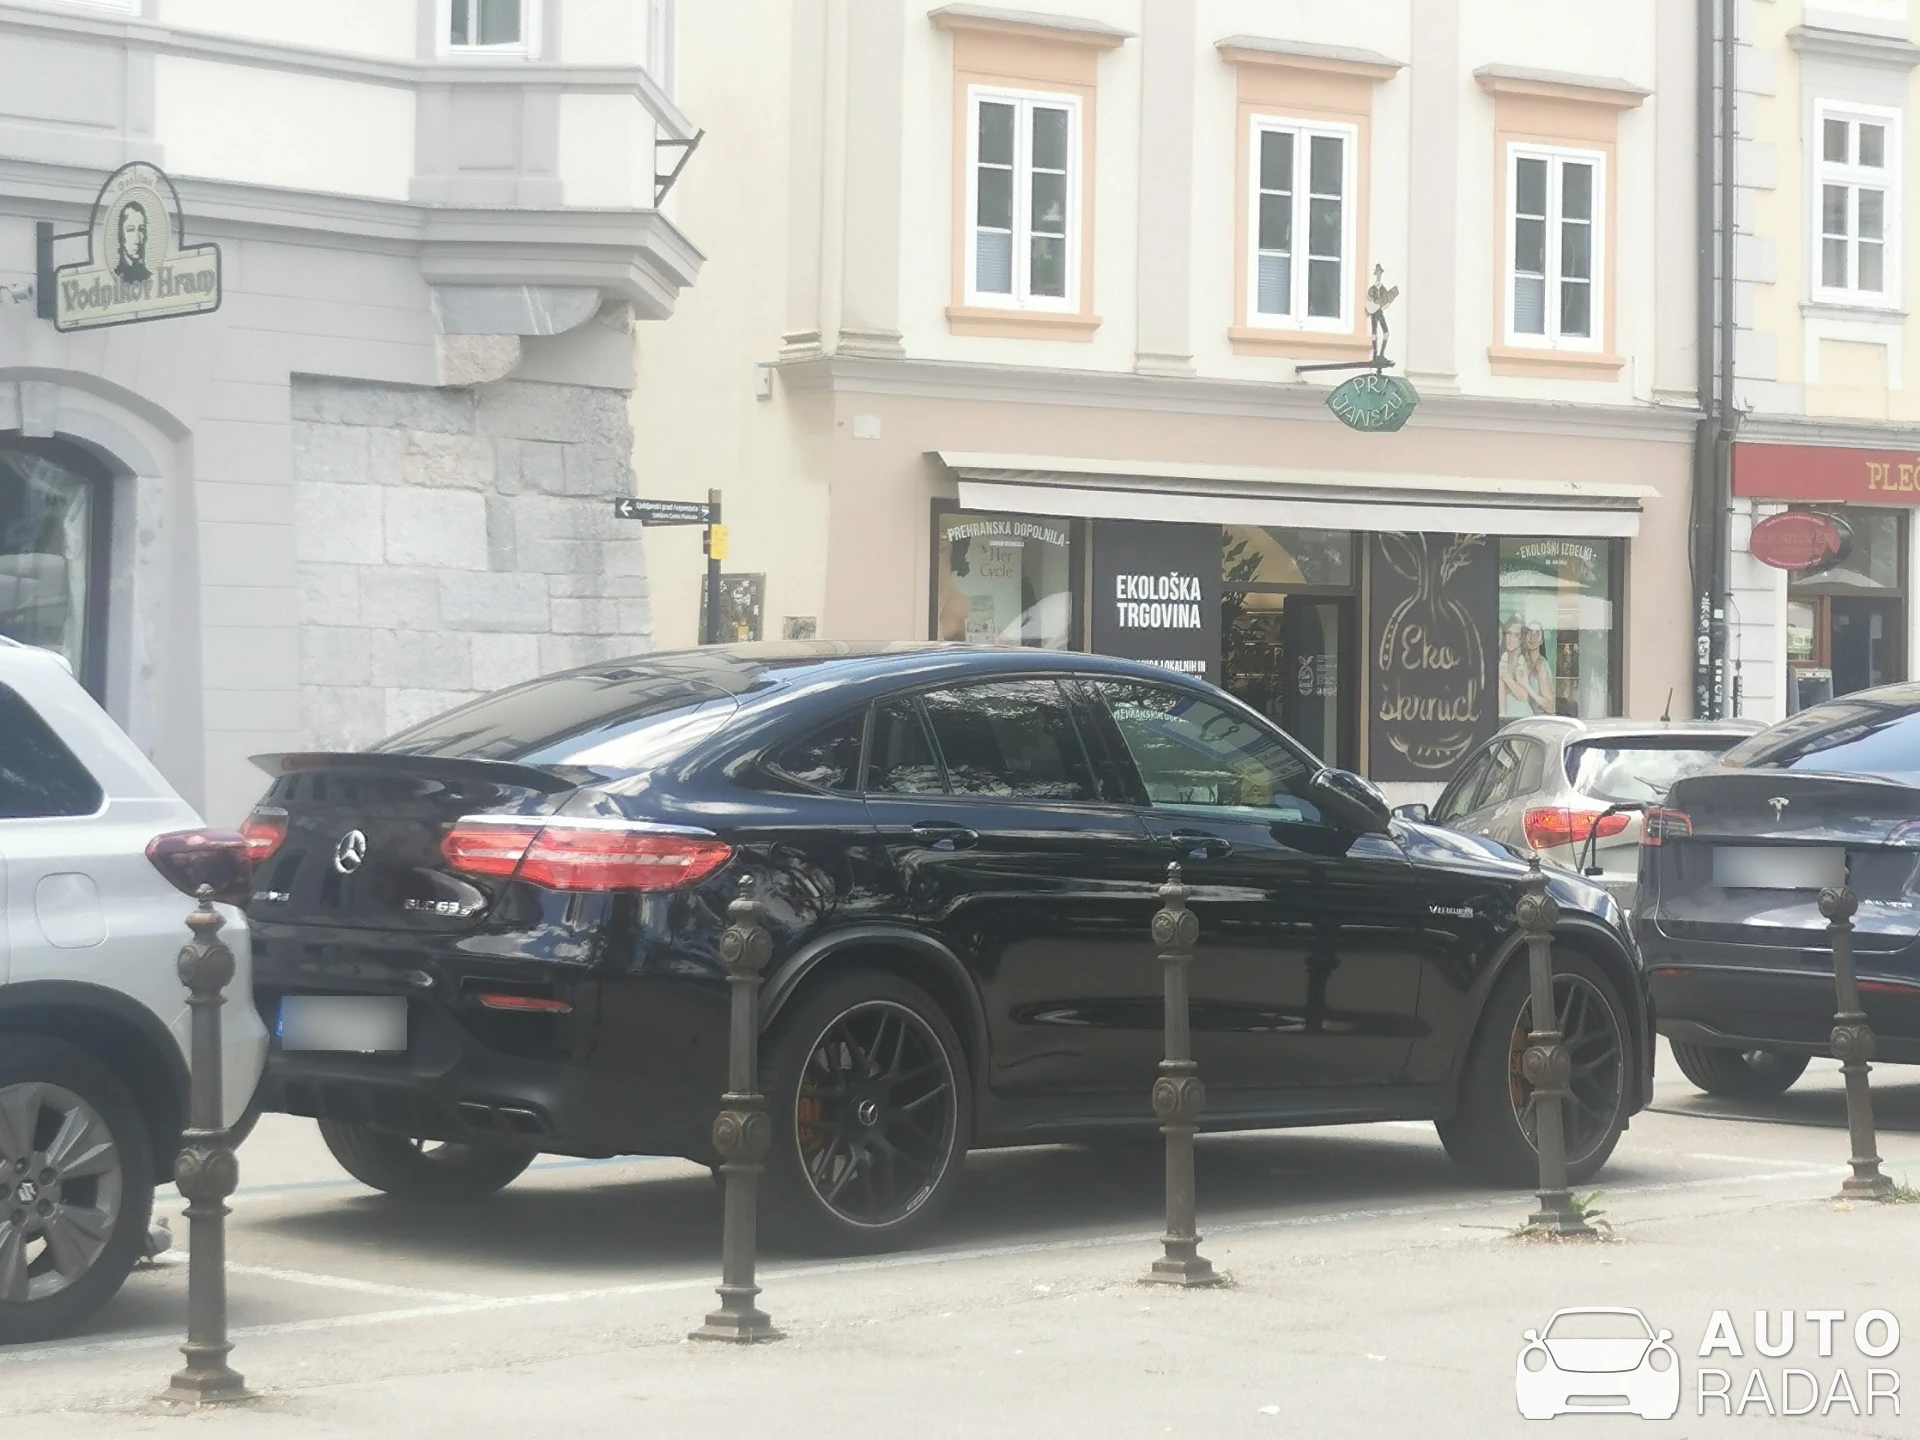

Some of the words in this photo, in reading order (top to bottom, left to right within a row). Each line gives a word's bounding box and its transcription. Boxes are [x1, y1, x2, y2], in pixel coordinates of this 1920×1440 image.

[62, 273, 154, 312] Vodnikov
[155, 265, 215, 297] Hram
[1353, 375, 1389, 395] PRI
[1332, 391, 1402, 427] JANEZU
[947, 520, 1012, 541] PREHRANSKA
[1013, 522, 1066, 547] DOPOLNILA
[989, 547, 1013, 562] Her
[1519, 541, 1560, 558] EKOLOŠKI
[1561, 543, 1593, 560] IZDELKI
[979, 563, 1013, 577] Cycle
[1116, 572, 1202, 601] EKOLOŠKA
[1116, 602, 1202, 629] TRGOVINA
[1400, 624, 1460, 669] Eko
